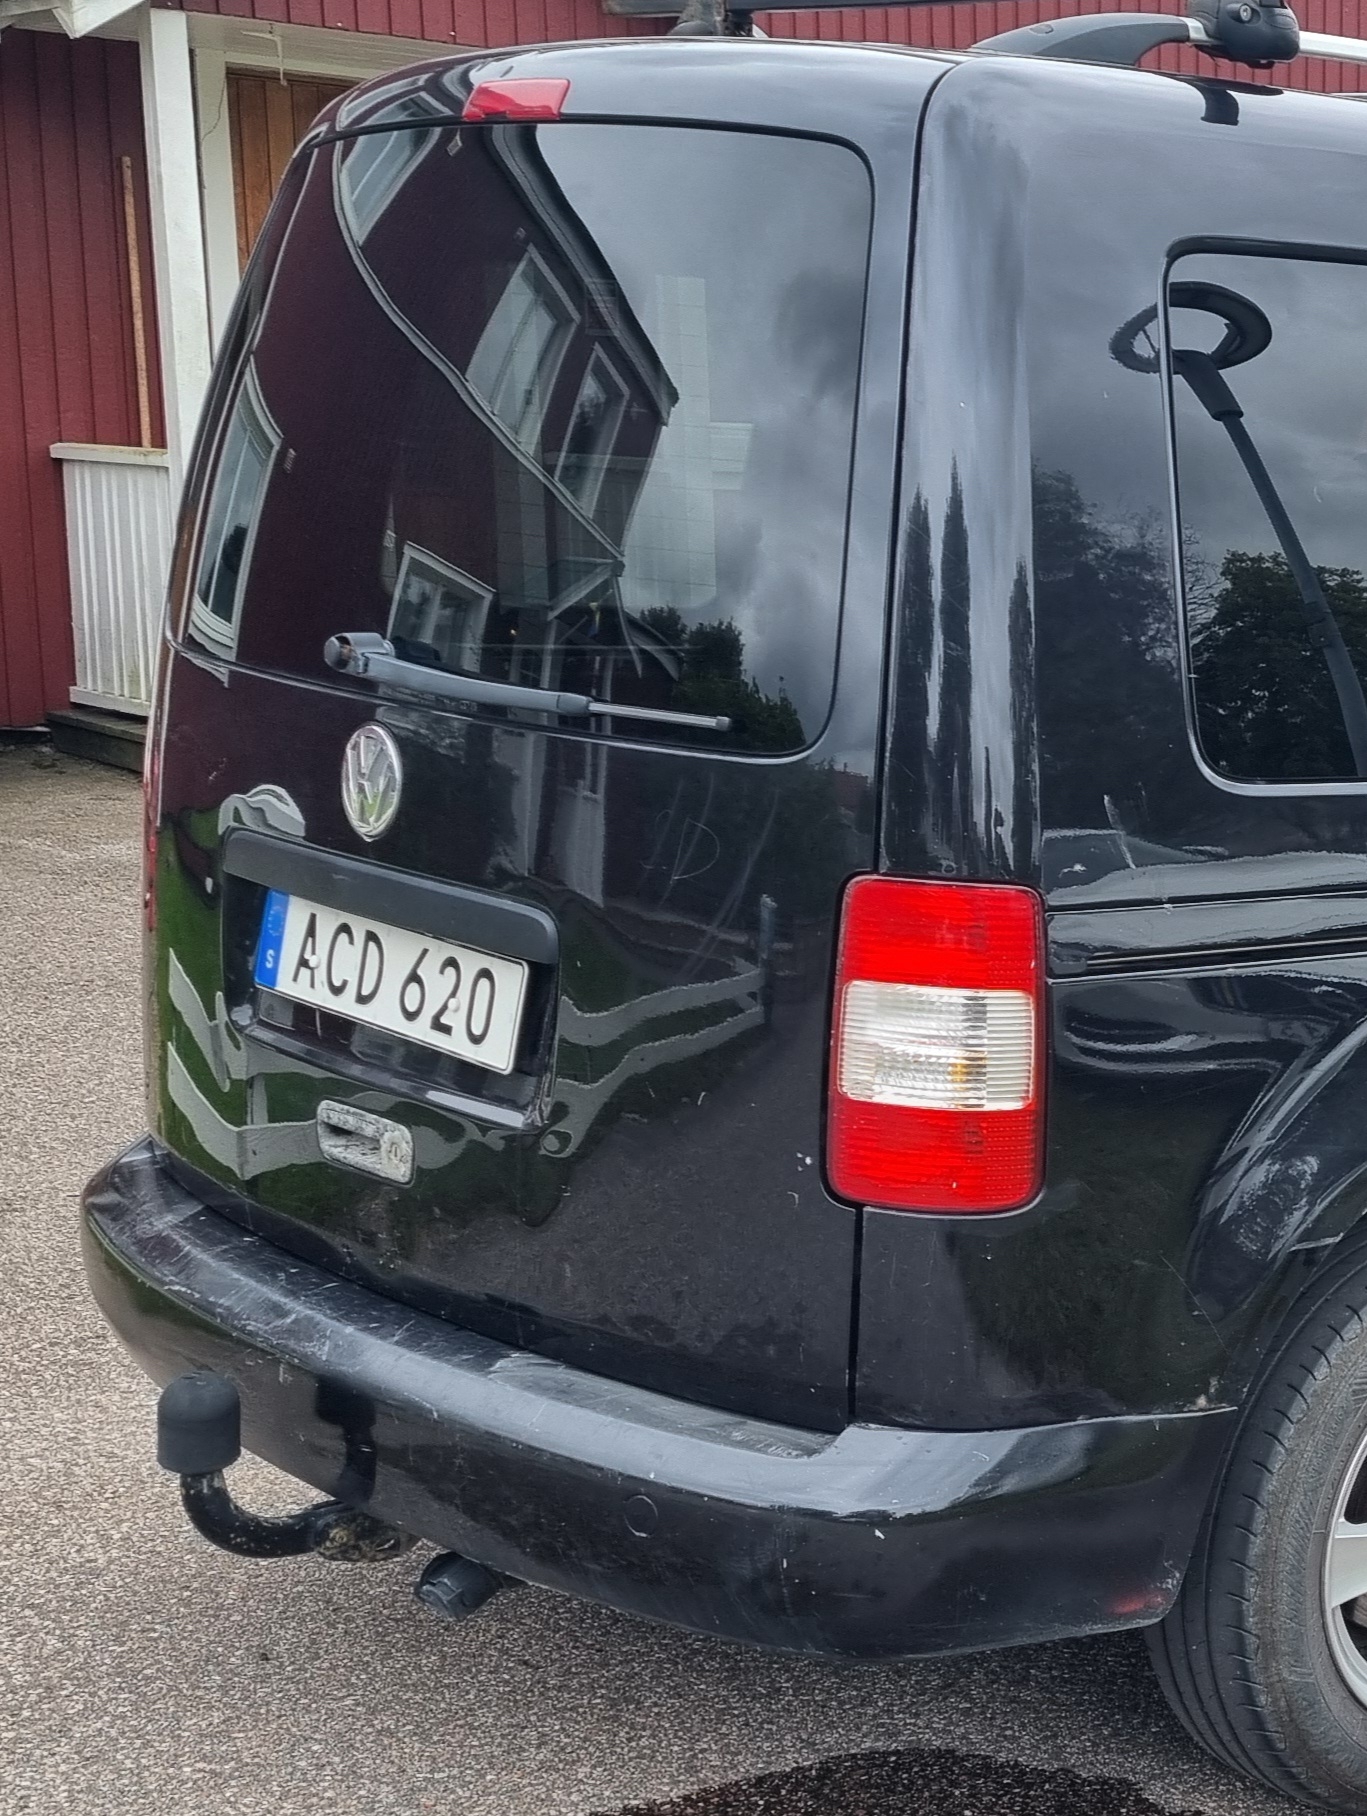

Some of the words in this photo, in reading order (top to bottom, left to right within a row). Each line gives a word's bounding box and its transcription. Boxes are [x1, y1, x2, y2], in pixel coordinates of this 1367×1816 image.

[344, 730, 399, 830] VW
[265, 949, 275, 969] S
[292, 912, 385, 1005] ACD
[399, 947, 496, 1046] 620
